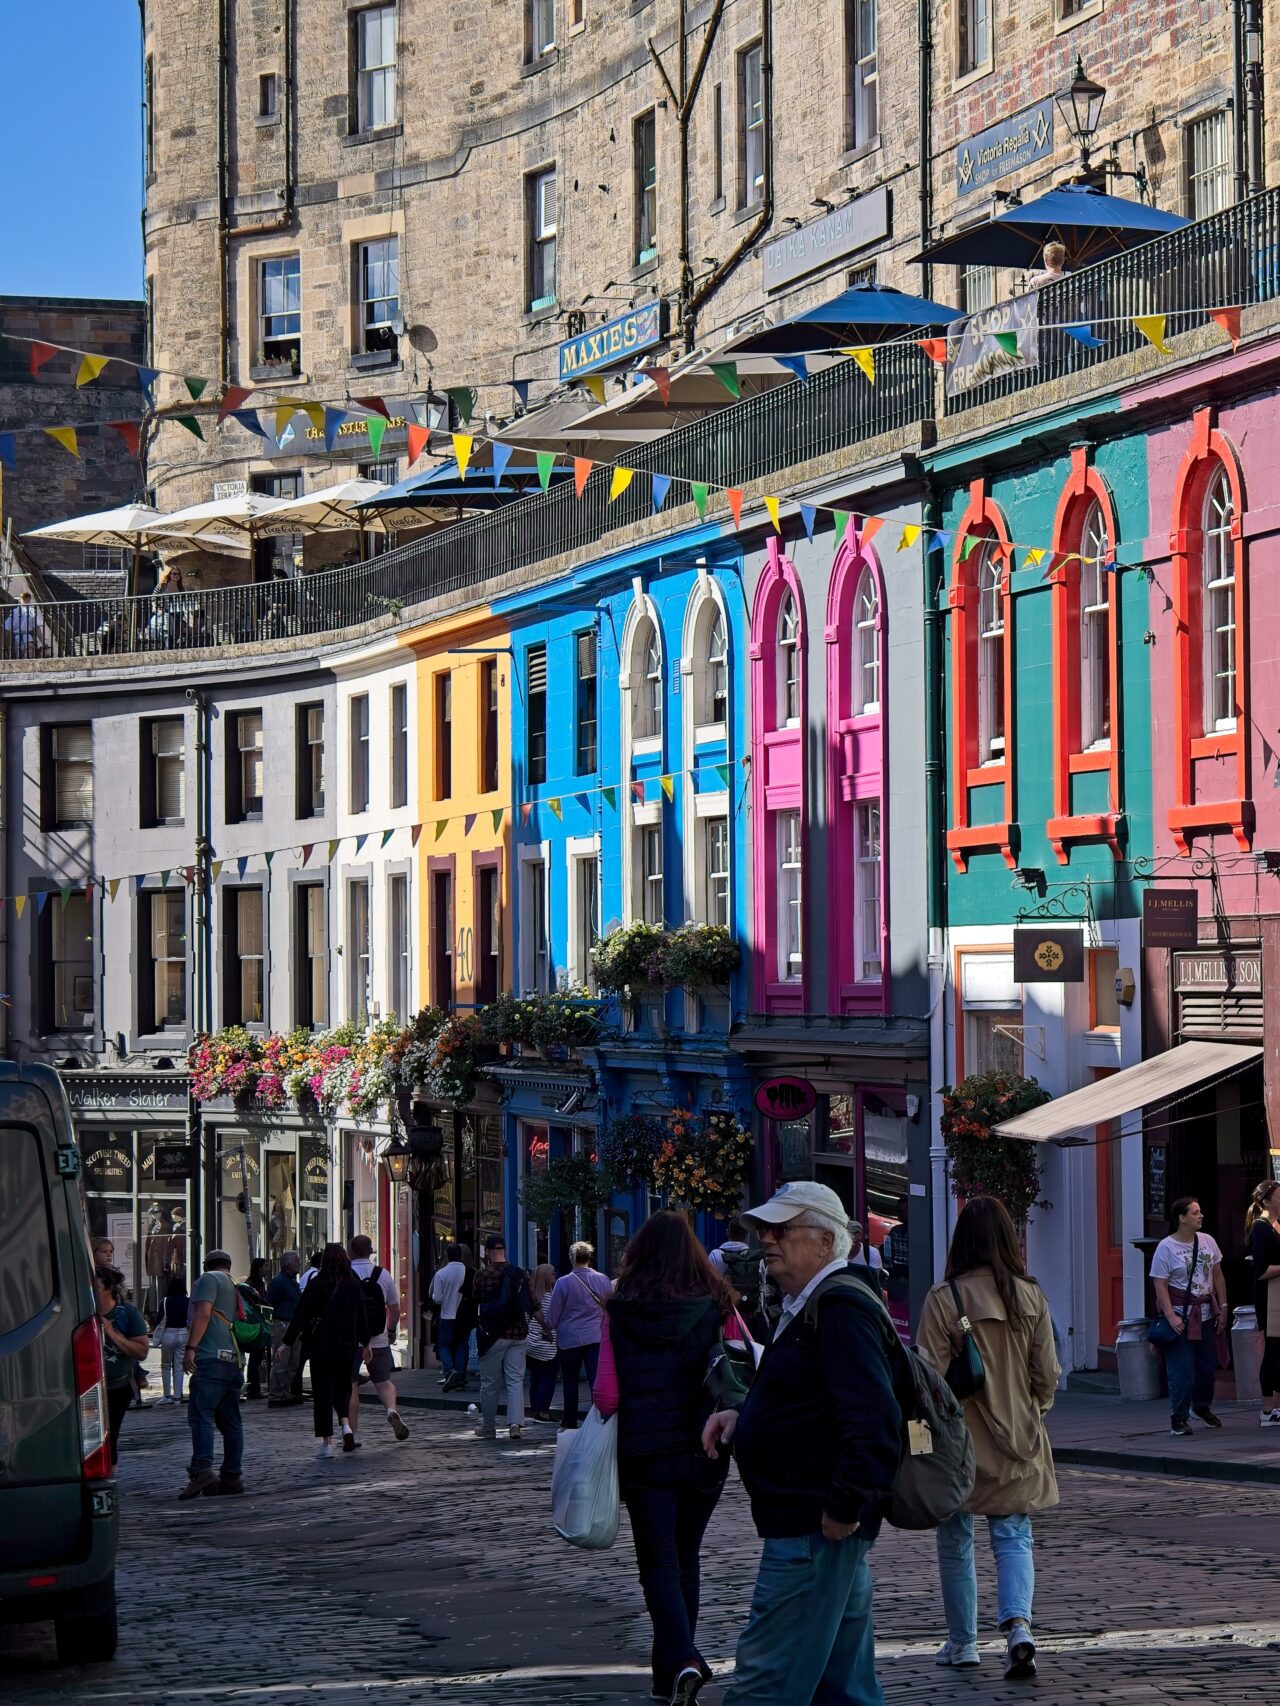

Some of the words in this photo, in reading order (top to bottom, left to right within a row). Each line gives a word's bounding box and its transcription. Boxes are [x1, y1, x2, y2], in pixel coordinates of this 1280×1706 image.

[977, 141, 1003, 166] Victoria
[1004, 128, 1030, 154] Regalia
[975, 169, 990, 184] SHOP
[971, 306, 1011, 346] SHOP
[562, 317, 637, 374] MAXIES
[216, 482, 246, 491] VICTORIA
[457, 927, 474, 982] 40
[1240, 961, 1260, 983] SON
[69, 1087, 120, 1107] Walker
[129, 1087, 172, 1107] Slater
[85, 1149, 112, 1168] SCOTTISH
[113, 1150, 131, 1168] TWEED
